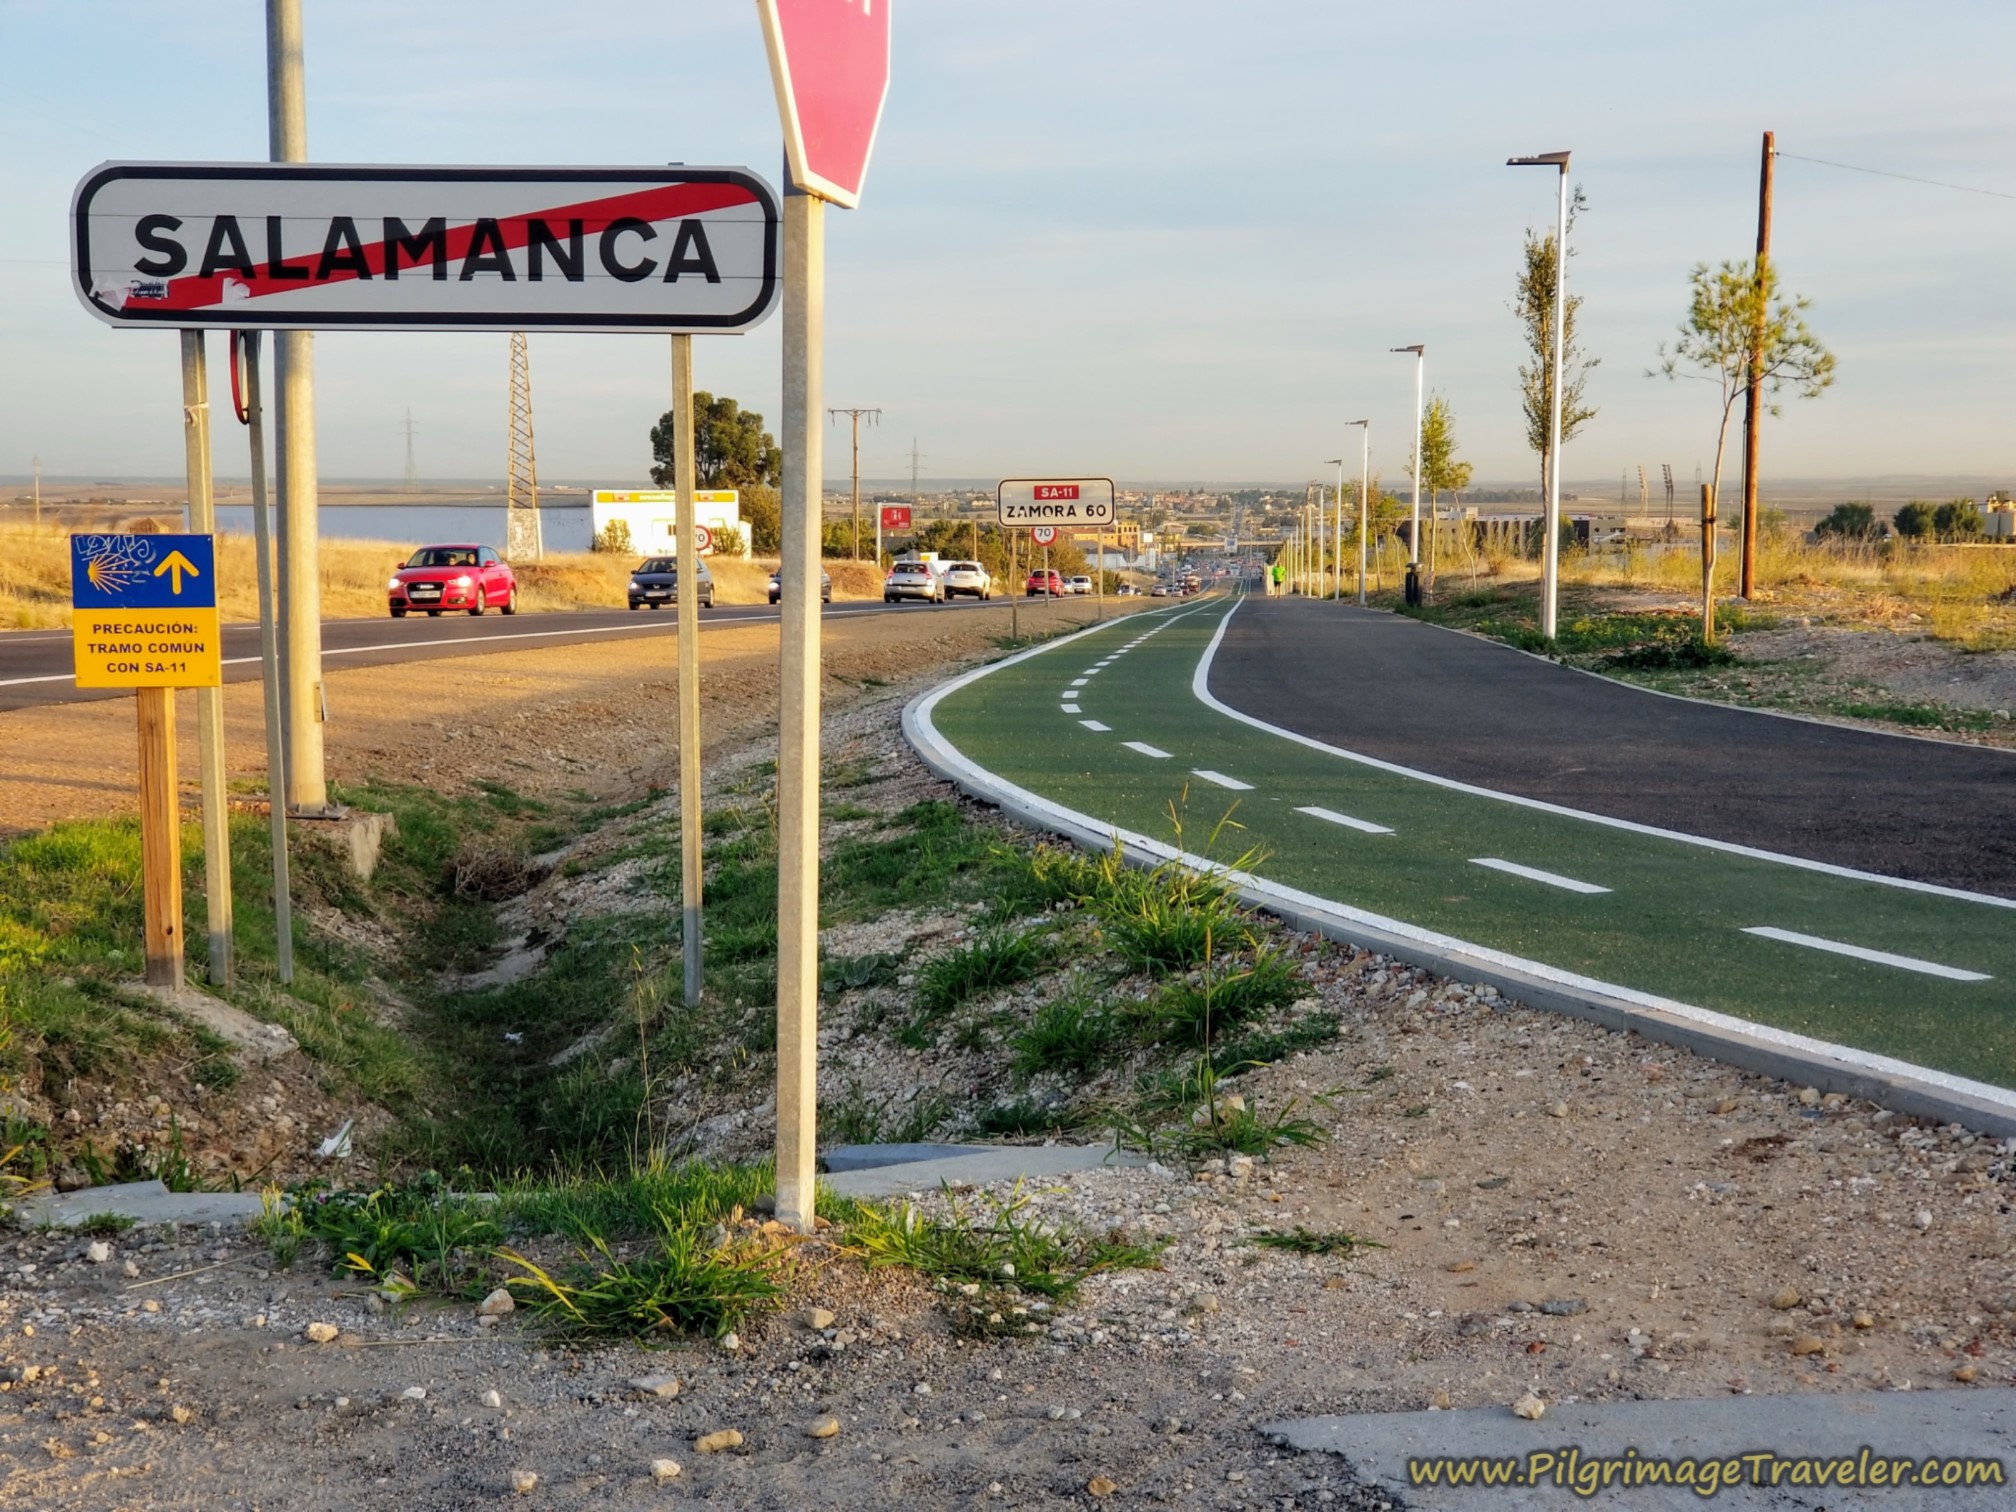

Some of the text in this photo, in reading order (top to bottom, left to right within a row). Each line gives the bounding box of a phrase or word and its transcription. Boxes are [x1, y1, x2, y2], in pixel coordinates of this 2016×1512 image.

[132, 213, 722, 284] SALAMANCA
[1041, 487, 1073, 498] SA-11
[1006, 504, 1107, 518] ZAMORA 60
[1037, 528, 1051, 537] 70
[92, 621, 198, 634] PRECAUCIÓN:
[87, 640, 205, 653] TRAMO COMÚN
[106, 662, 186, 673] CON SA-11
